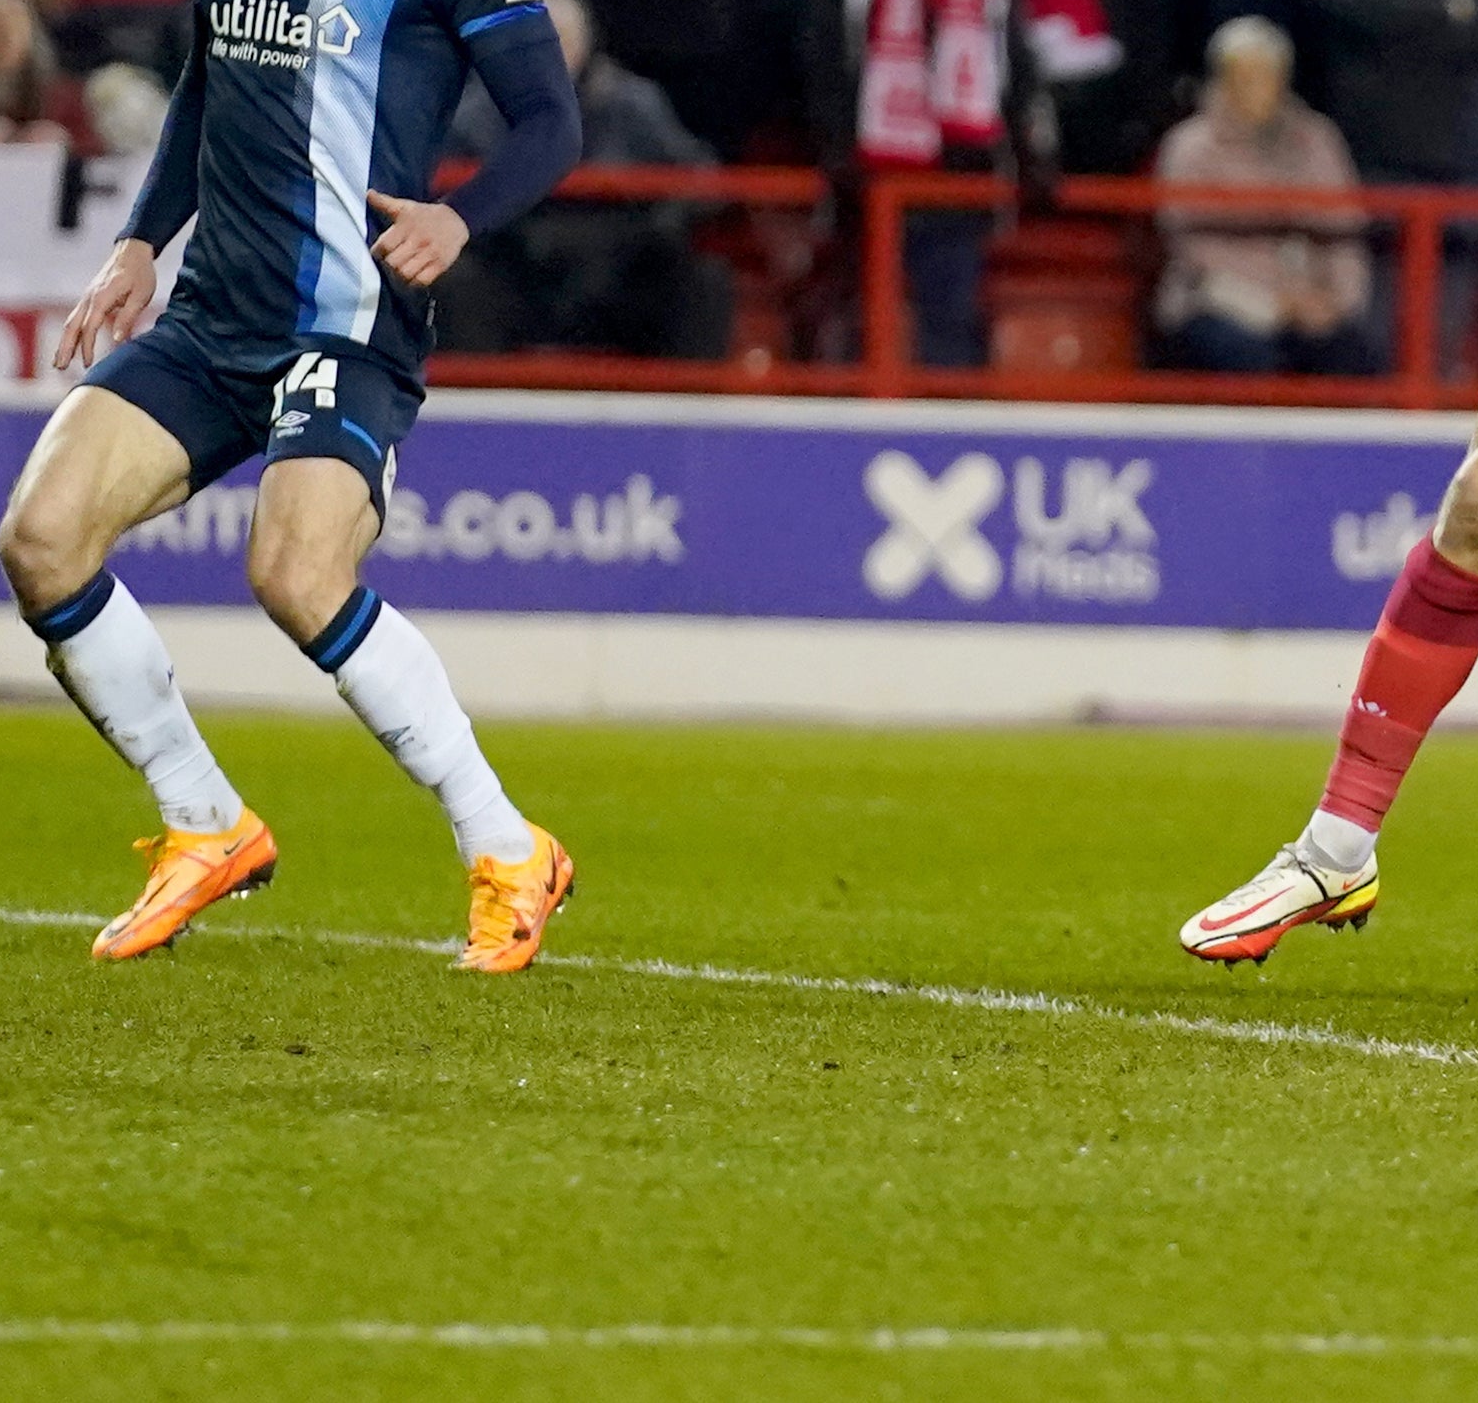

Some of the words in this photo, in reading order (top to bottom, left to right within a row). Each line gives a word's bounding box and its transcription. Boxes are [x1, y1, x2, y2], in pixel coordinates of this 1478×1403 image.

[229, 42, 258, 62] with
[258, 47, 312, 70] power
[270, 351, 339, 423] 14
[1013, 456, 1157, 546] UK
